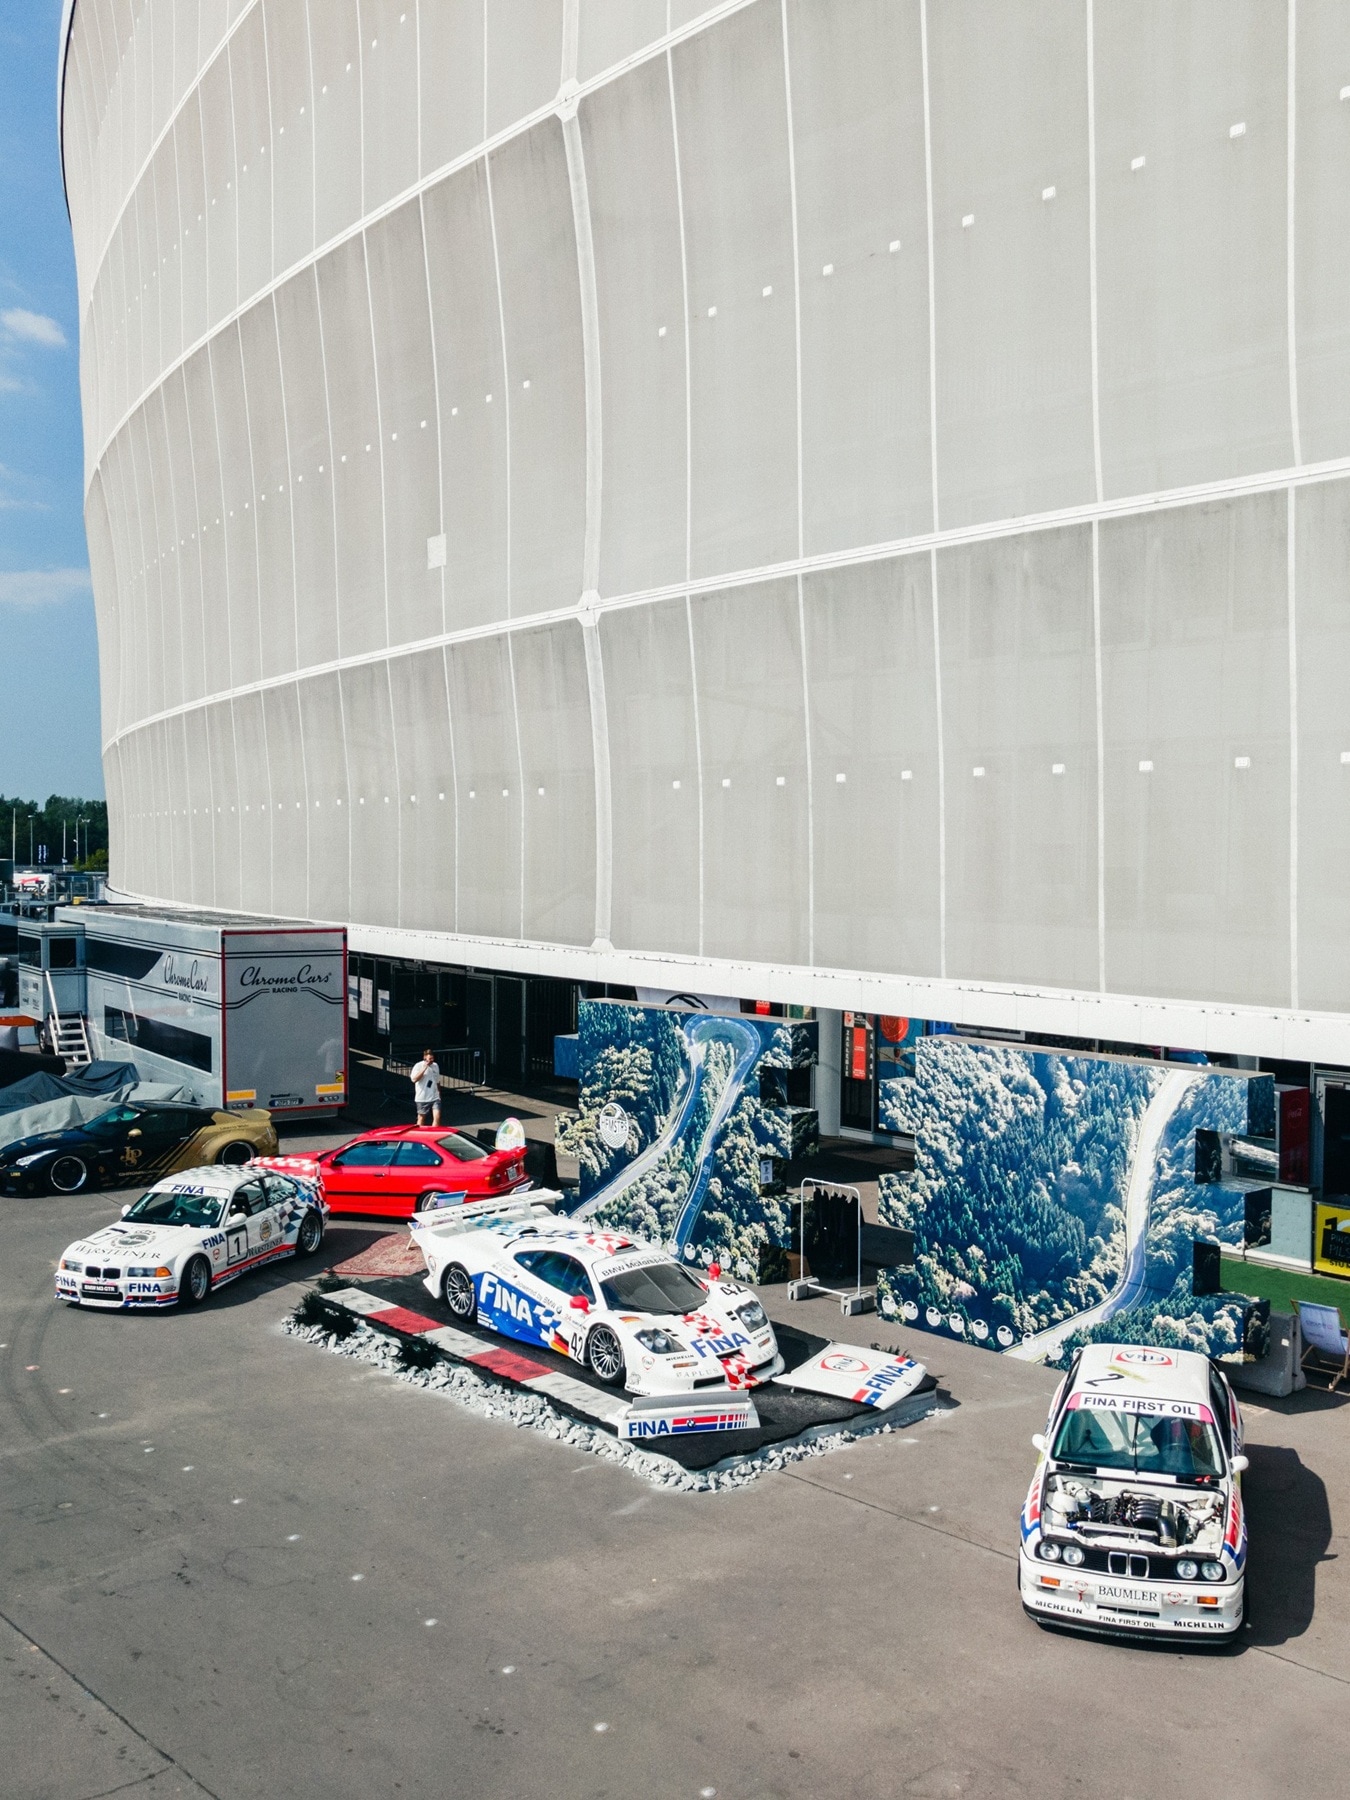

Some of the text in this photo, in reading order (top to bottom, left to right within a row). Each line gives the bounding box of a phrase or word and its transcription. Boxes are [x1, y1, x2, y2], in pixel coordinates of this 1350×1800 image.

[171, 1185, 204, 1195] FINA
[202, 1233, 225, 1250] FINA
[234, 1237, 240, 1255] 1
[601, 1257, 670, 1277] BMW Motorsport
[55, 1275, 77, 1288] FINA
[129, 1283, 162, 1293] FINA
[720, 1283, 748, 1296] 42
[480, 1272, 533, 1328] FINA
[571, 1332, 583, 1363] 42
[690, 1332, 752, 1358] FINA
[833, 1357, 856, 1373] FINA
[865, 1365, 910, 1391] FINA
[1084, 1396, 1196, 1416] FINA FIRST OIL
[629, 1419, 670, 1437] FINA
[1098, 1585, 1158, 1602] BAUMLER
[1035, 1600, 1083, 1615] MICHELIN
[1098, 1615, 1156, 1628] FINA FIRST OIL
[1173, 1620, 1225, 1629] MICHELIN
